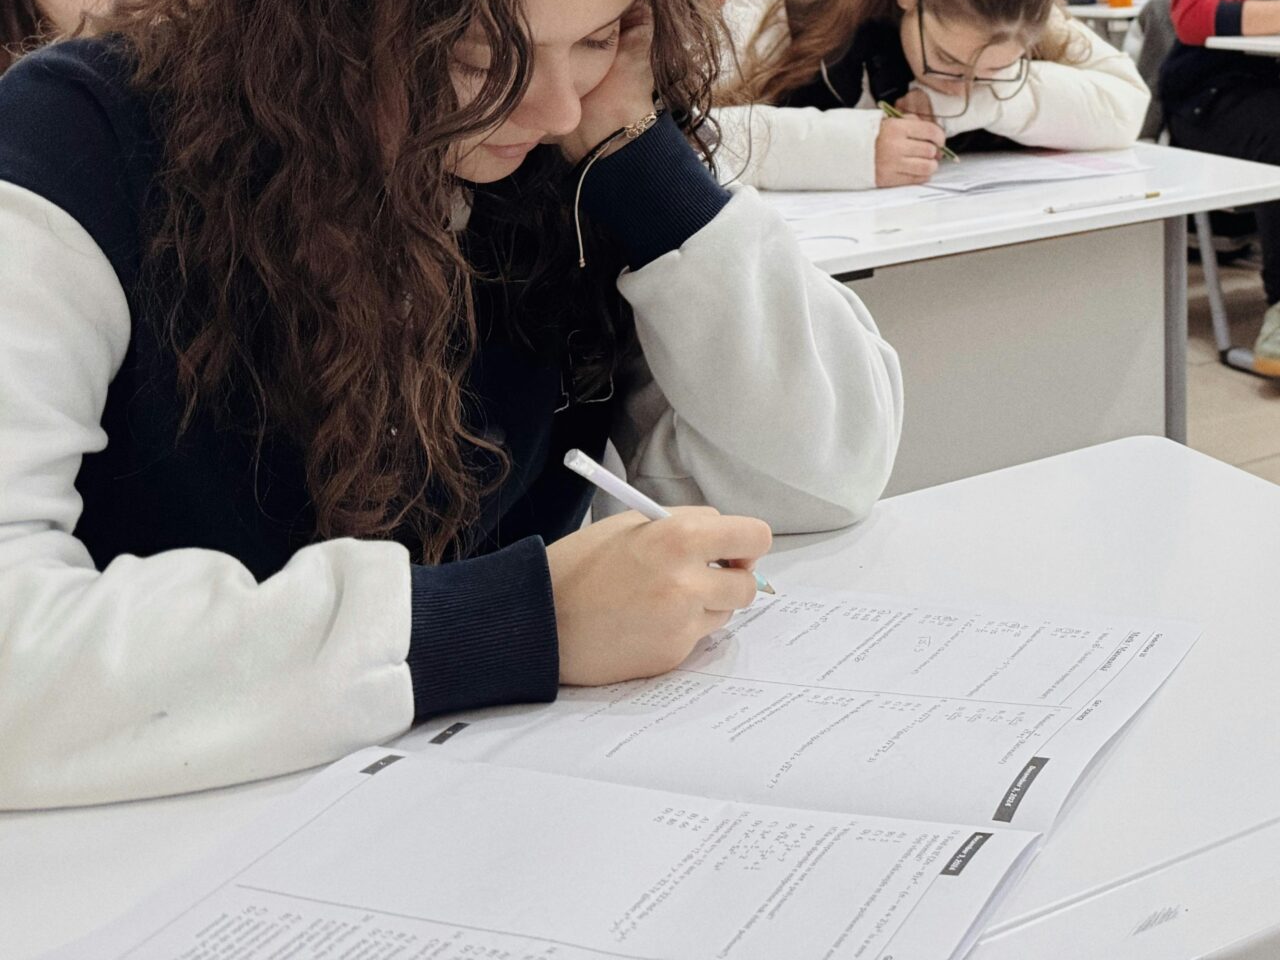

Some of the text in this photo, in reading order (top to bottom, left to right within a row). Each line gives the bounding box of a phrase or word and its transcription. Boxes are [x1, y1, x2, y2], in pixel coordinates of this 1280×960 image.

[1123, 631, 1141, 643] Math
[1013, 764, 1038, 787] December
[1000, 791, 1019, 809] 2024
[960, 834, 984, 854] December
